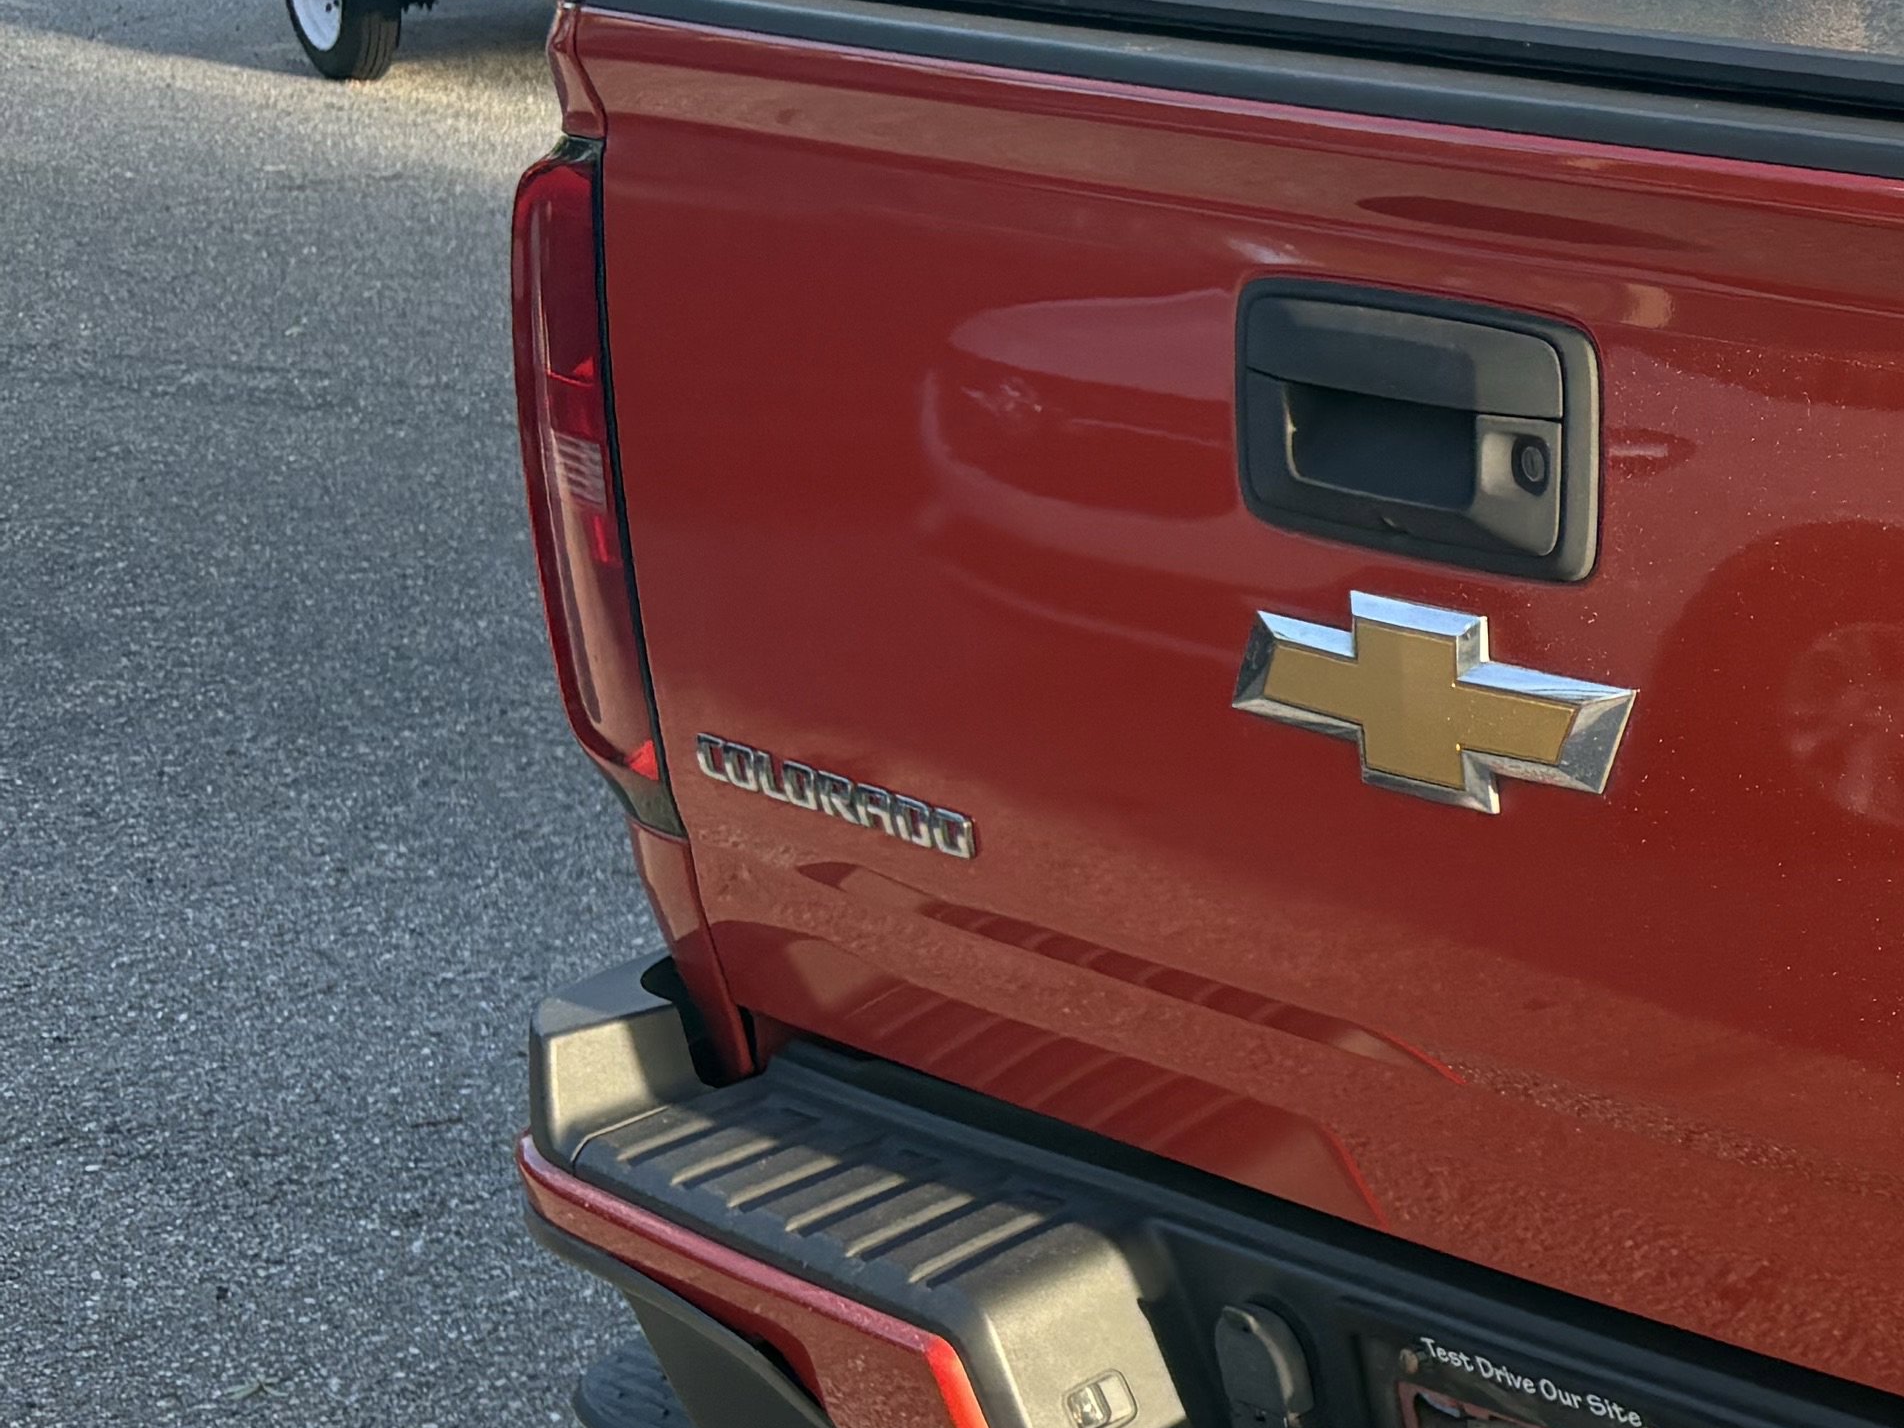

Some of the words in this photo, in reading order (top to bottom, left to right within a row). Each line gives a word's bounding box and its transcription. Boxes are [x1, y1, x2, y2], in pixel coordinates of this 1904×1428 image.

[696, 732, 977, 860] COLORADO
[1420, 1336, 1474, 1373] Test
[1475, 1355, 1537, 1395] Drive
[1538, 1378, 1583, 1410] Our
[1586, 1393, 1643, 1428] Site
